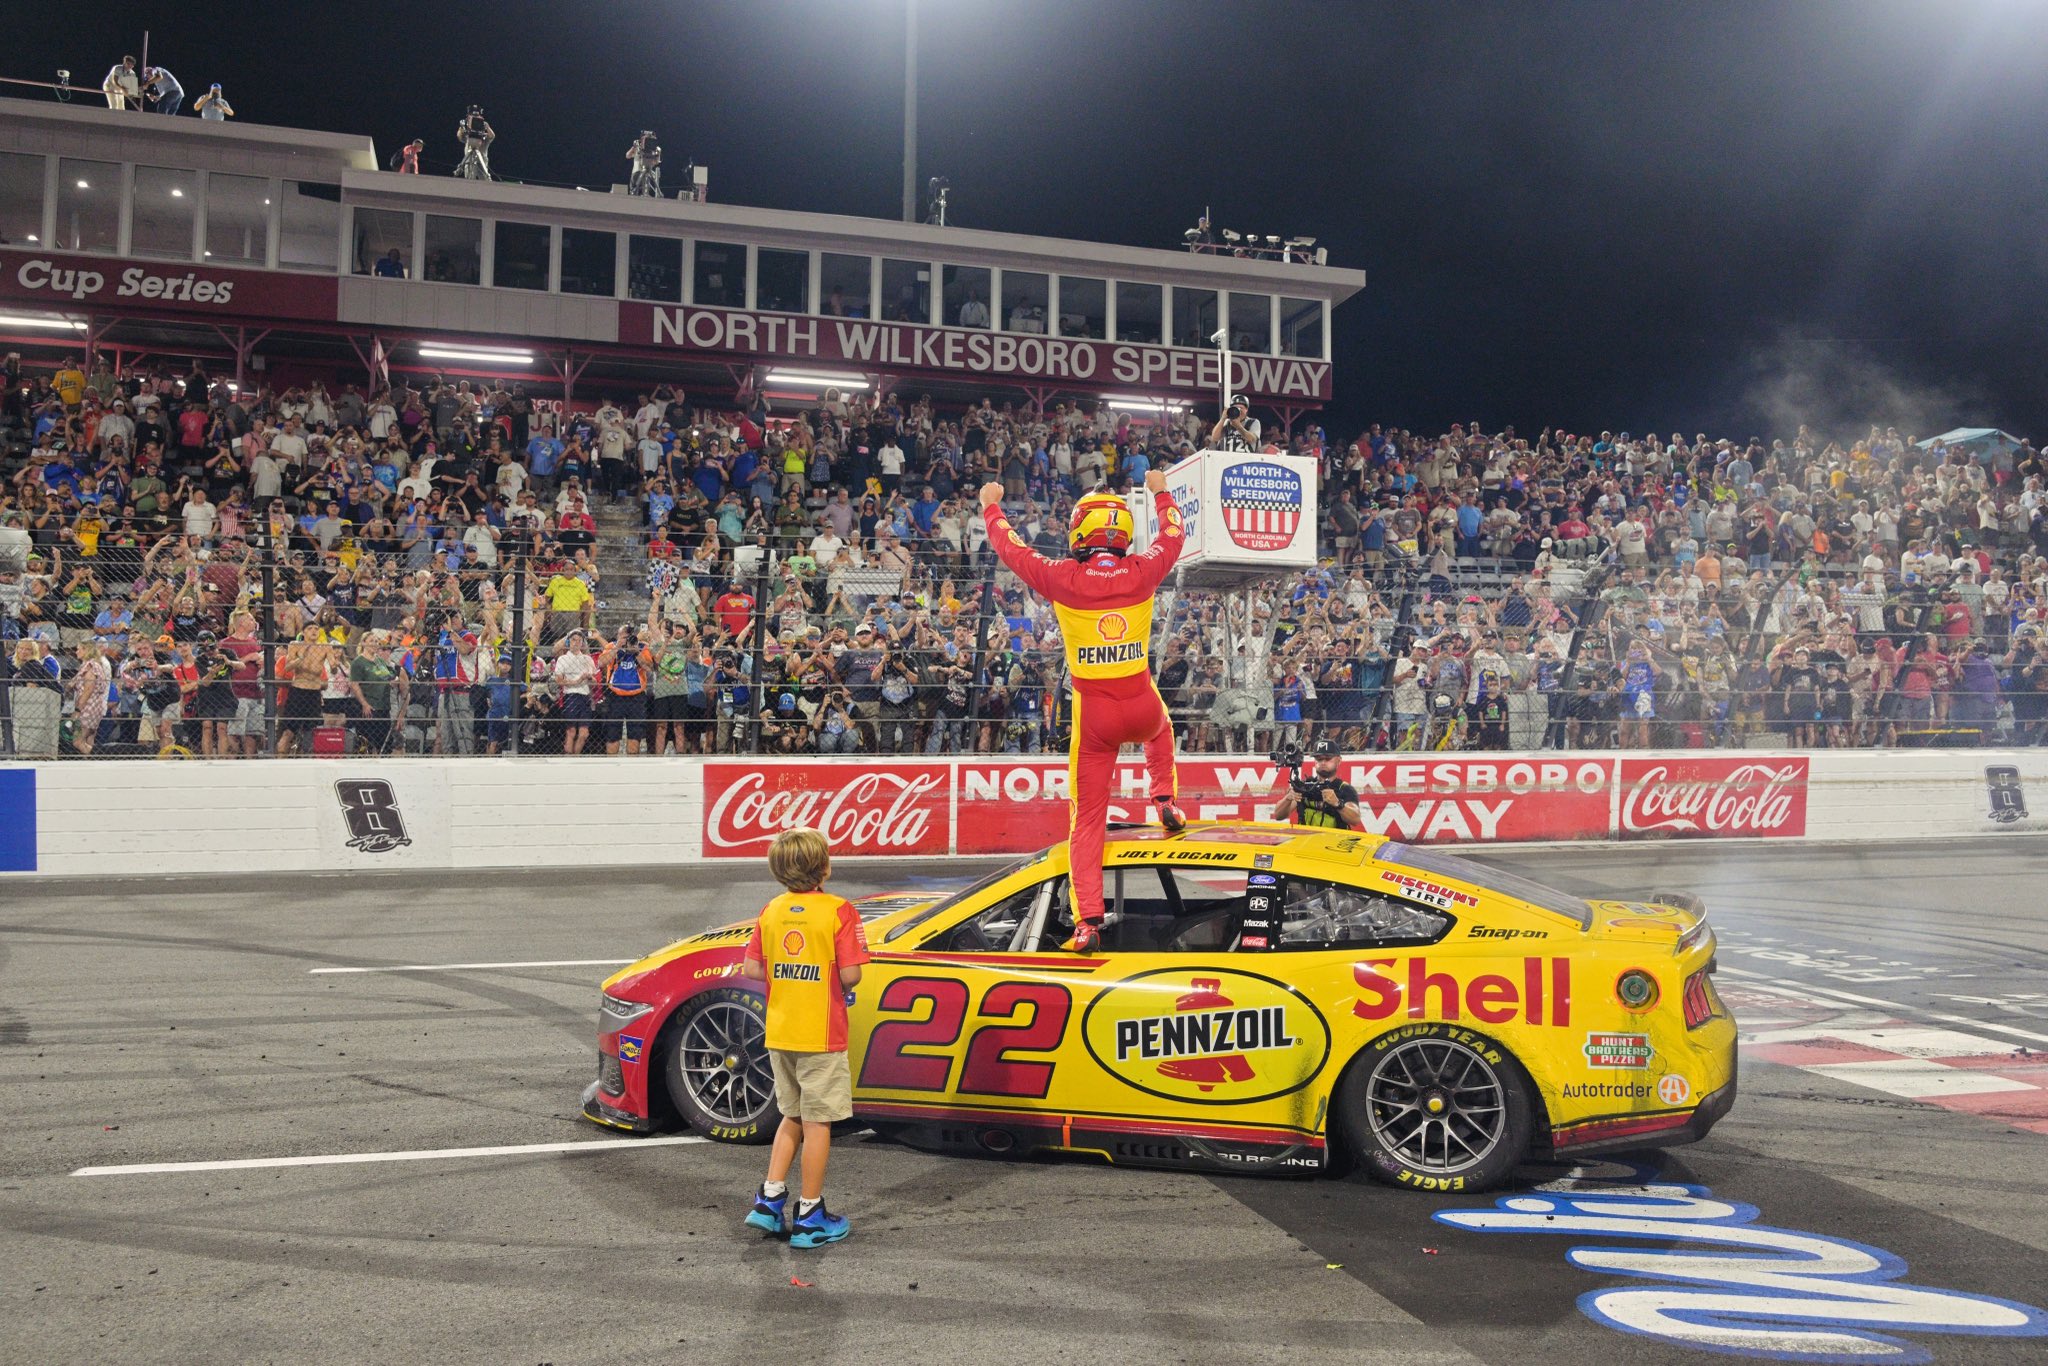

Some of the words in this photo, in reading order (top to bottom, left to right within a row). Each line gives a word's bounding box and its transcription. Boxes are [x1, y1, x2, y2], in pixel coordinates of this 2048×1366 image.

[18, 260, 104, 299] Cup
[117, 267, 233, 304] Series
[653, 307, 817, 355] NORTH
[836, 323, 1097, 380] WILKESBORO
[1112, 347, 1329, 397] SPEEDWAY
[1242, 465, 1282, 478] NORTH
[1224, 477, 1299, 490] WILKESBORO
[1171, 484, 1187, 503] RTH
[1231, 489, 1292, 502] SPEEDWAY
[1251, 540, 1271, 548] USA
[1078, 641, 1144, 664] PENNZOIL
[965, 767, 1152, 803] NORH
[1214, 763, 1606, 798] WKESBORO
[1984, 765, 2027, 814] 8
[1623, 764, 1806, 832] Coca-Cola
[334, 778, 409, 842] 8
[707, 772, 946, 848] Coca-Cola
[1116, 850, 1164, 859] JOEY
[1167, 851, 1239, 861] LOGANO
[1381, 871, 1479, 907] DISCOUNT
[1405, 888, 1447, 906] TIRE
[1250, 898, 1268, 909] PPG
[1243, 919, 1269, 928] Mazak
[1468, 925, 1549, 940] Snap-on
[773, 963, 821, 981] ENNZOIL
[1353, 957, 1570, 1027] Shell
[857, 976, 1072, 1099] 22
[1117, 1007, 1294, 1061] PENNZOIL
[1601, 1037, 1634, 1046] HUNT
[1588, 1046, 1648, 1056] BROTHERS
[1600, 1055, 1636, 1064] PIZZA
[1562, 1082, 1653, 1098] Autotrader
[710, 1122, 758, 1139] EAGLE
[1396, 1169, 1465, 1191] EAGLE
